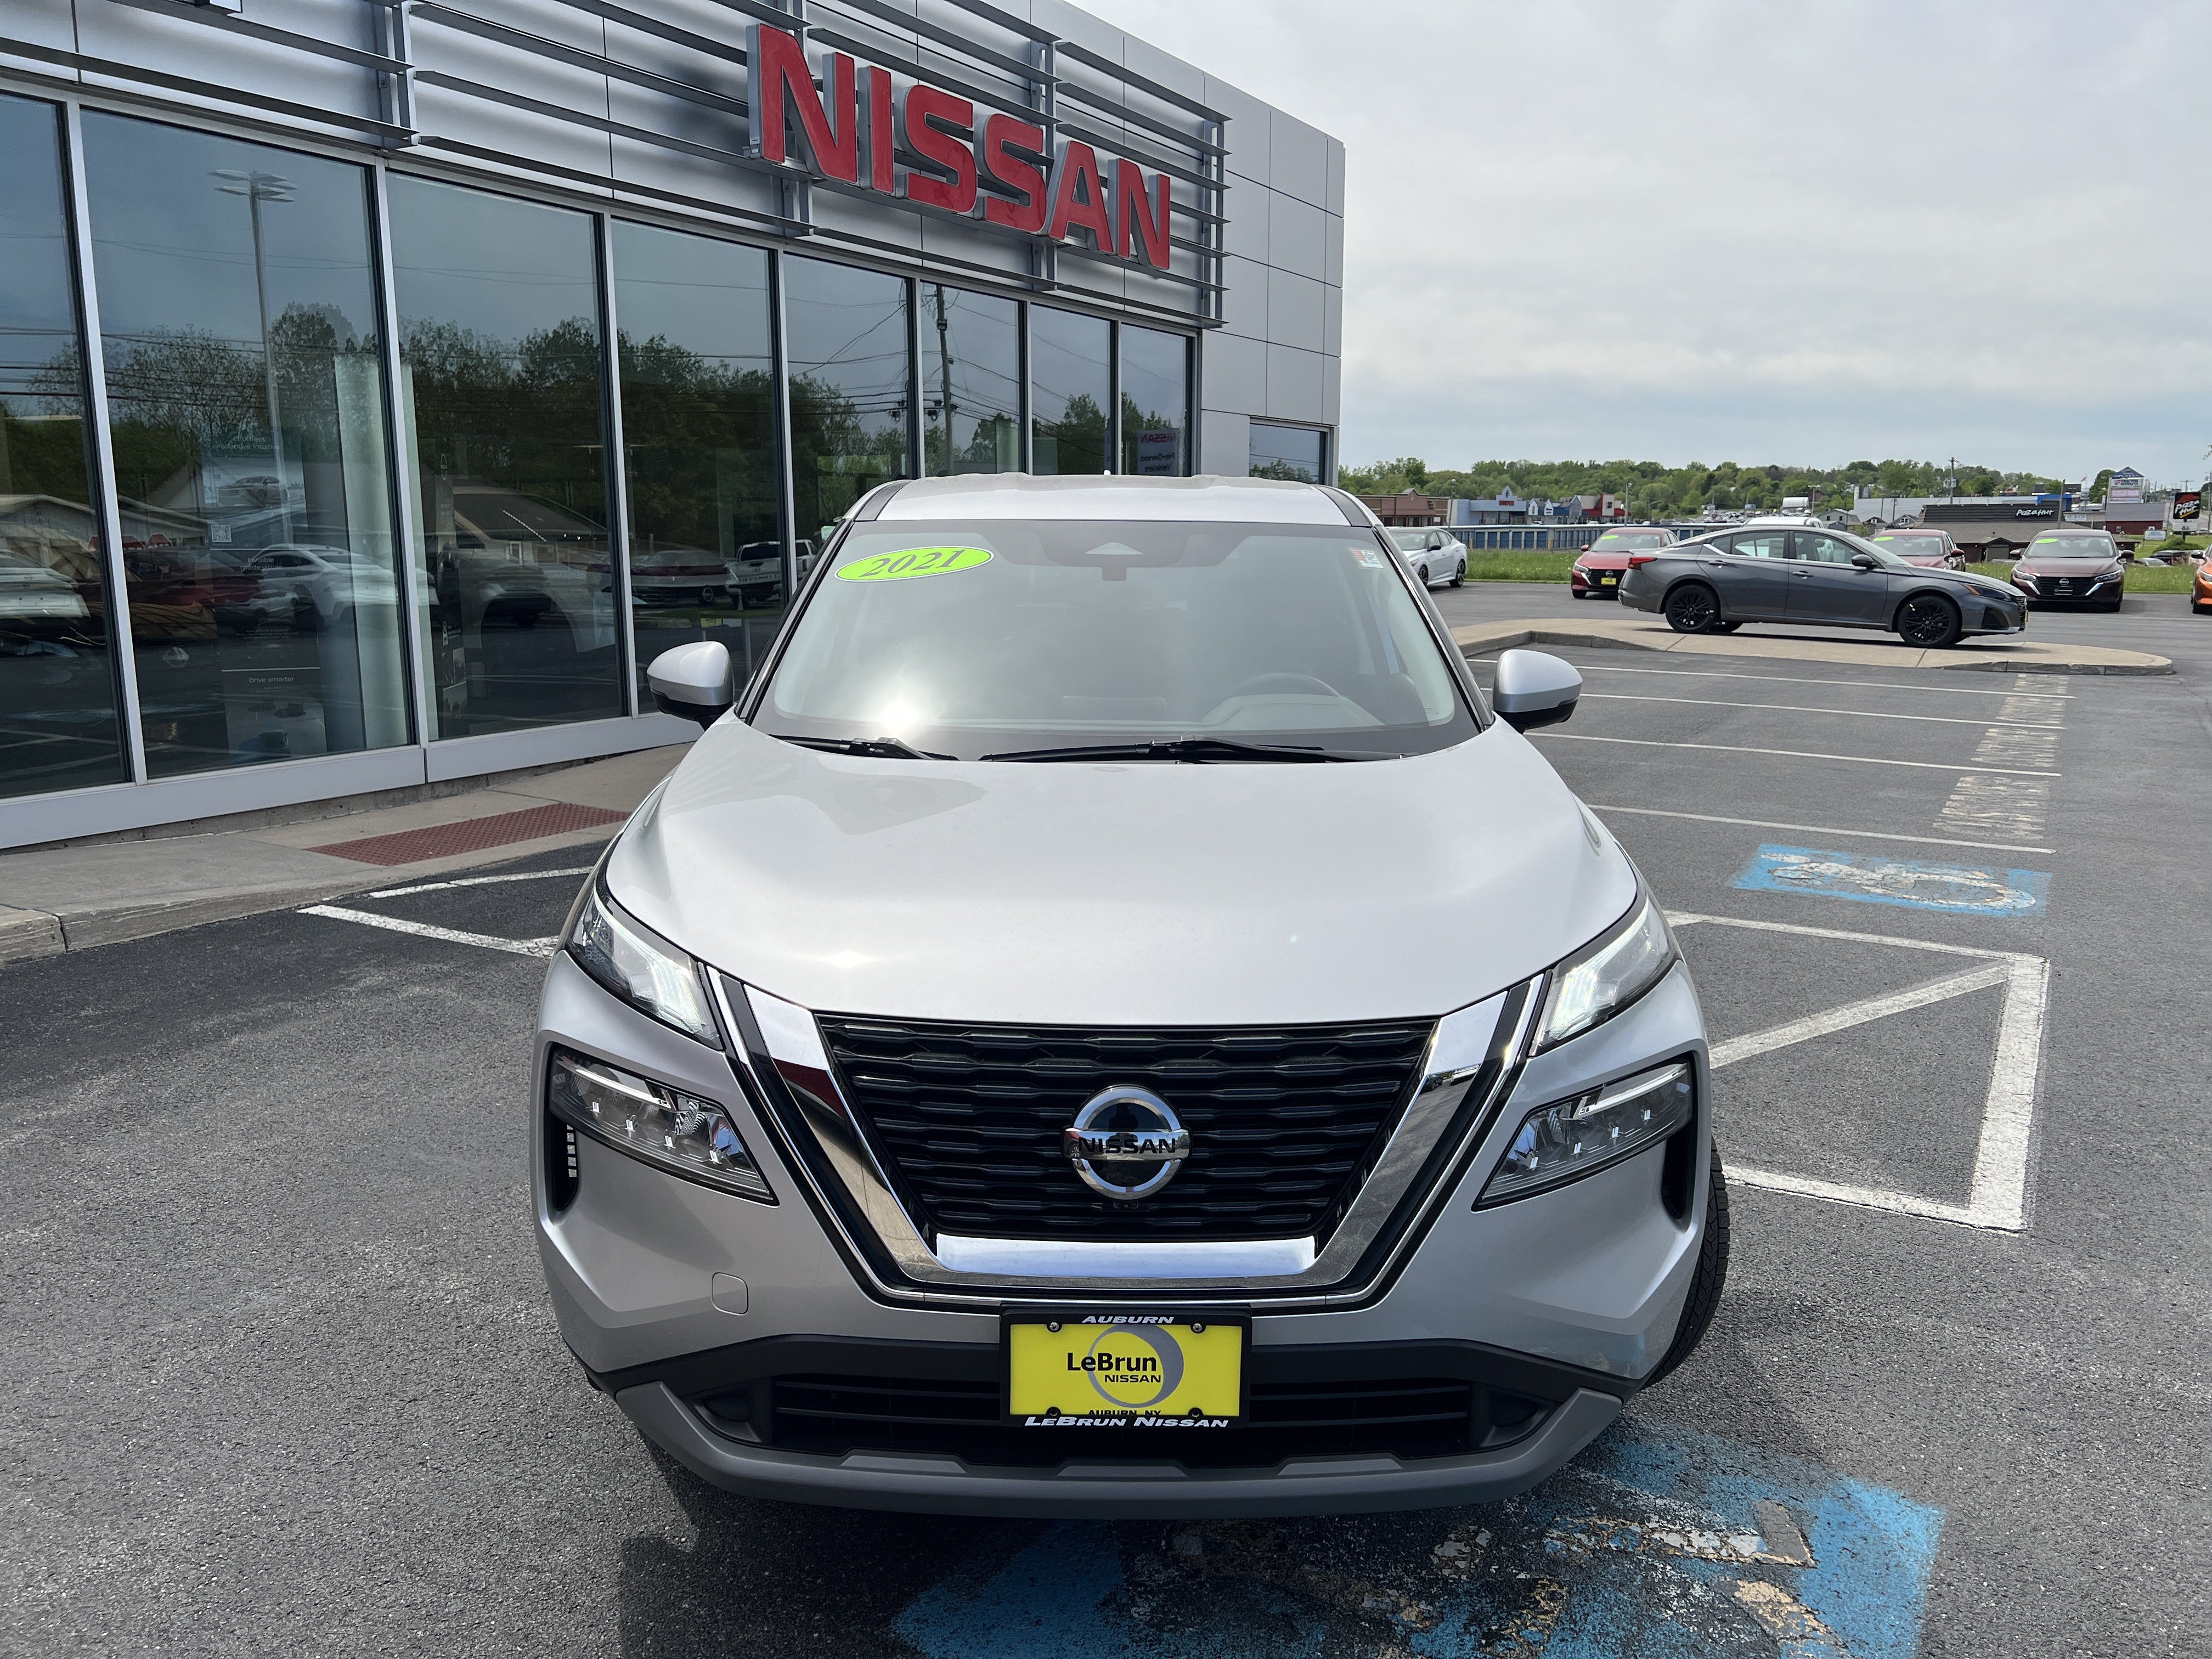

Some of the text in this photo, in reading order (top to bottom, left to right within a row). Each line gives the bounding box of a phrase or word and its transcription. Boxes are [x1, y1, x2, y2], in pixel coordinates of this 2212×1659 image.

[746, 24, 1170, 270] NISSAN
[2175, 500, 2200, 514] Pizza
[2179, 505, 2198, 516] Hut
[859, 549, 966, 578] 2021
[1078, 1137, 1176, 1154] NISSAN
[1082, 1316, 1174, 1324] AUBURN
[1067, 1352, 1157, 1372] LeBrun
[1104, 1374, 1161, 1383] NISSAN
